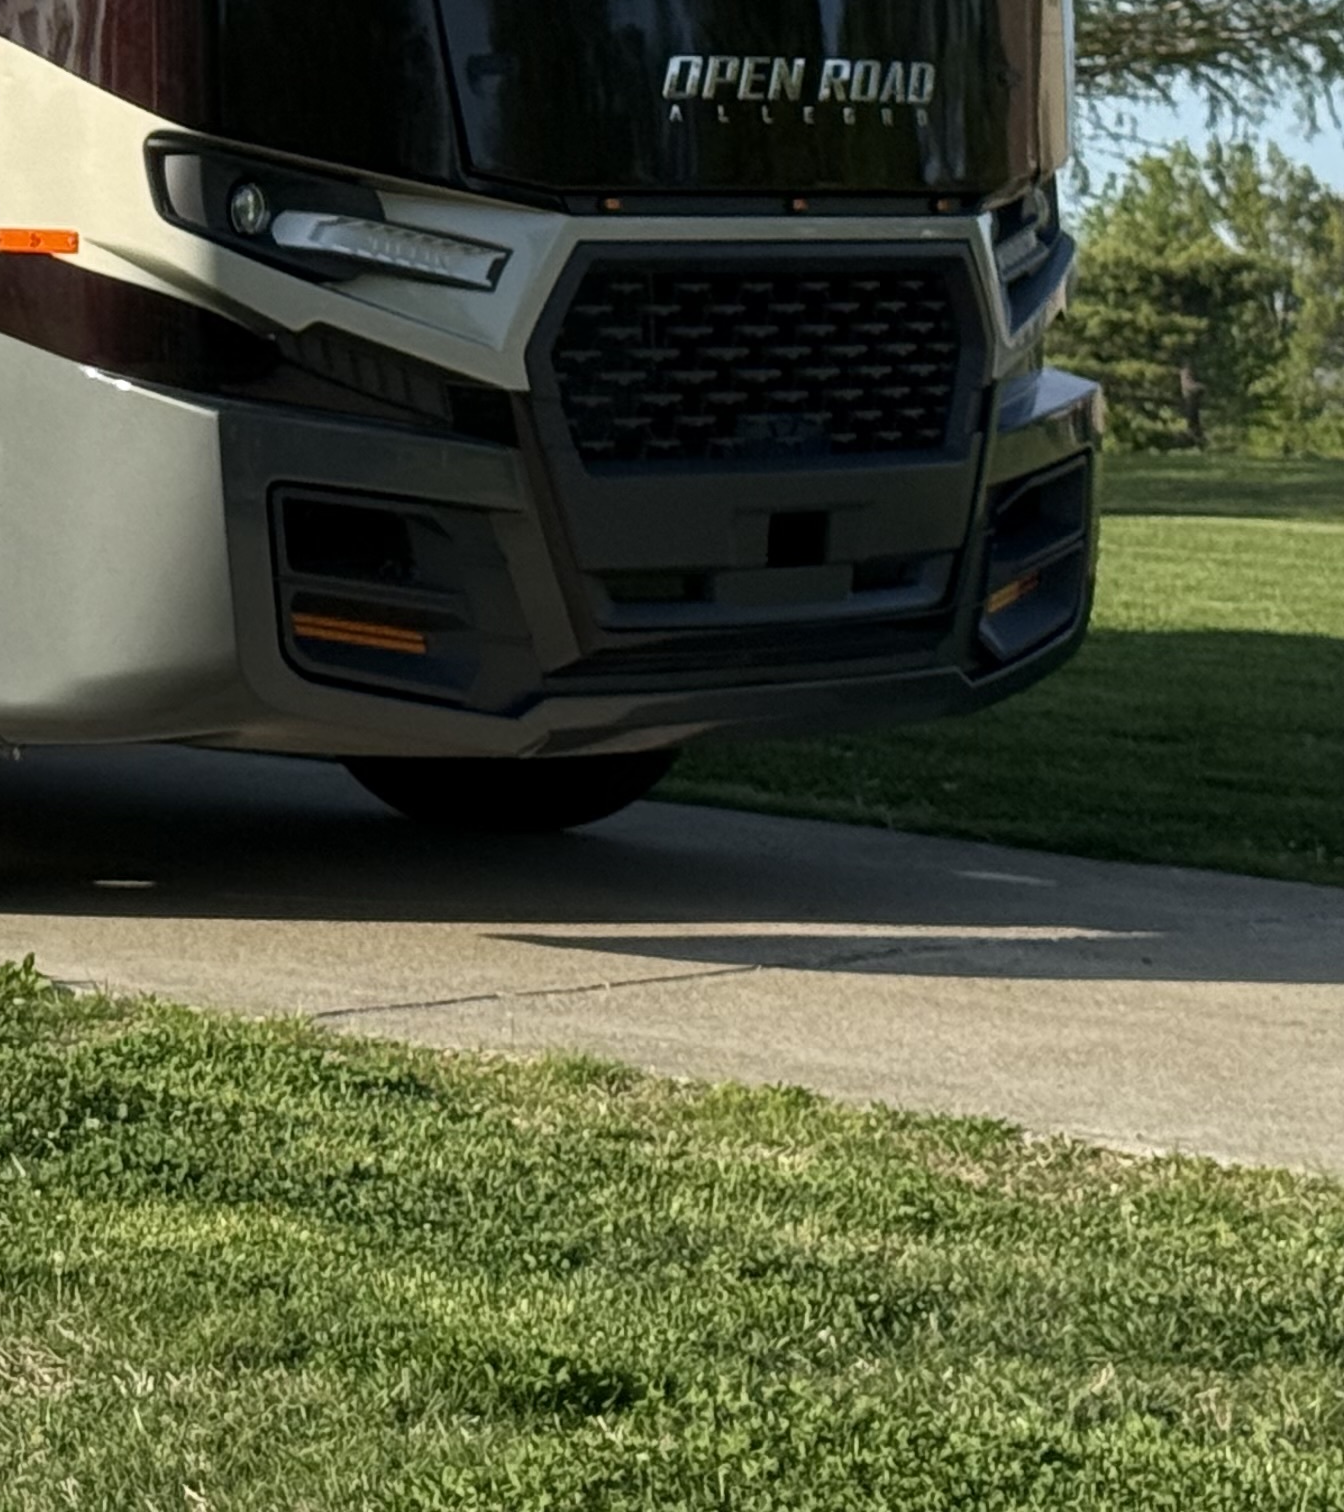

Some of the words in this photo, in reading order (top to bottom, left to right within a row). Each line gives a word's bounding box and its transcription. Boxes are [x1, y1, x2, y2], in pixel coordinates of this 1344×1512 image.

[662, 55, 806, 100] OPEN
[817, 59, 935, 104] ROAD
[669, 104, 928, 126] ALLEGRO
